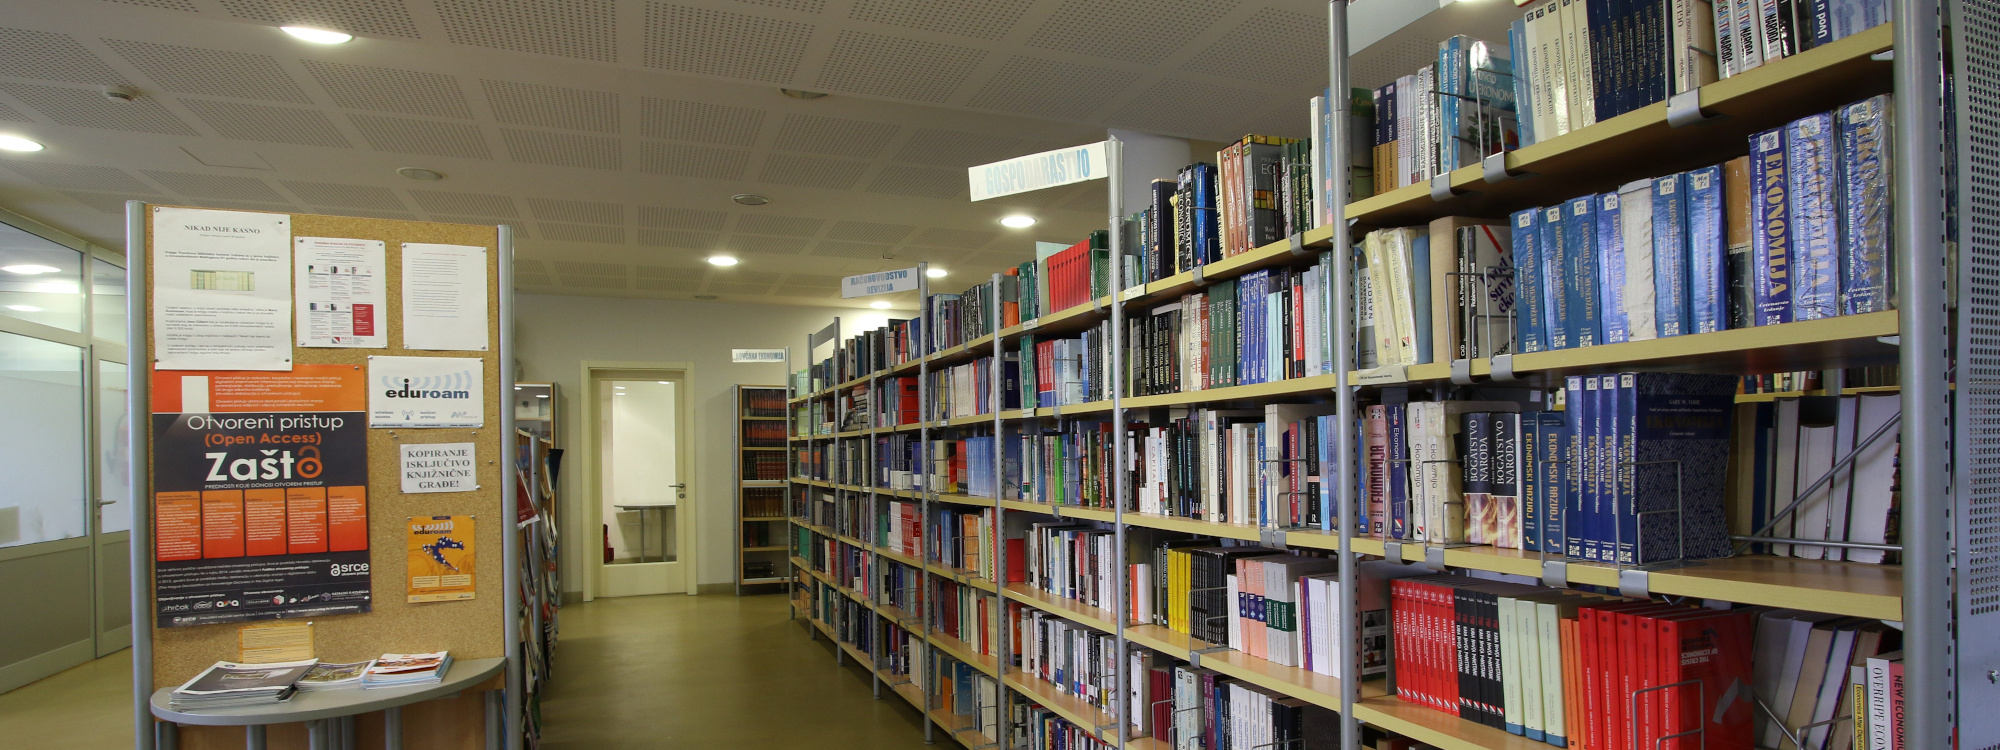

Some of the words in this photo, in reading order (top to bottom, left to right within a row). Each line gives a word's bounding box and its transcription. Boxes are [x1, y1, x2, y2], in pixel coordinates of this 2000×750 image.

[1817, 3, 1825, 11] u
[1765, 14, 1779, 44] NARODA
[1816, 12, 1828, 38] Uvod
[1720, 35, 1733, 64] NARODA
[1757, 186, 1765, 220] Samuelson
[1806, 138, 1830, 287] EKONOMIJA
[1766, 151, 1786, 298] EKONOMIJA
[1526, 234, 1535, 273] EKONOMIJA
[1555, 226, 1563, 264] EKONOMIJA
[1582, 223, 1591, 263] EKONOMIJA
[1758, 229, 1766, 254] William
[851, 270, 907, 286] RAČUNOVODSTVO
[1528, 274, 1535, 284] ZA
[1557, 268, 1564, 277] ZA
[1584, 266, 1590, 275] ZA
[866, 283, 893, 294] REVIZIJA
[1585, 277, 1594, 321] MENEDŽERE
[1529, 285, 1538, 328] MENEDŽERE
[386, 378, 469, 398] eduroam
[187, 415, 274, 430] Otvoreni
[280, 416, 343, 431] pristup
[205, 433, 255, 447] (Open
[260, 432, 322, 445] Access)
[408, 449, 468, 458] KOPIRANJE
[1469, 420, 1478, 482] BOGATSTVO
[1496, 420, 1504, 484] BOGATSTVO
[407, 459, 470, 468] ISKLJUČIVO
[1414, 443, 1422, 488] Ekonomija
[1479, 437, 1488, 482] NARODA
[1505, 438, 1514, 484] NARODA
[1525, 433, 1533, 482] EKONOMSKI
[1548, 433, 1558, 483] EKONOMSKI
[1570, 435, 1578, 492] EKONOMIJA
[407, 469, 470, 479] KNJIŽNIČNE
[419, 480, 459, 488] GRAĐE!
[1370, 445, 1385, 503] EKONOMIJA
[1526, 485, 1534, 518] RAZVOJ
[1549, 486, 1558, 521] RAZVOJ
[414, 525, 452, 535] eduroam
[341, 563, 369, 571] srce
[1873, 667, 1885, 721] OVERRIPE
[1894, 675, 1903, 697] NEW
